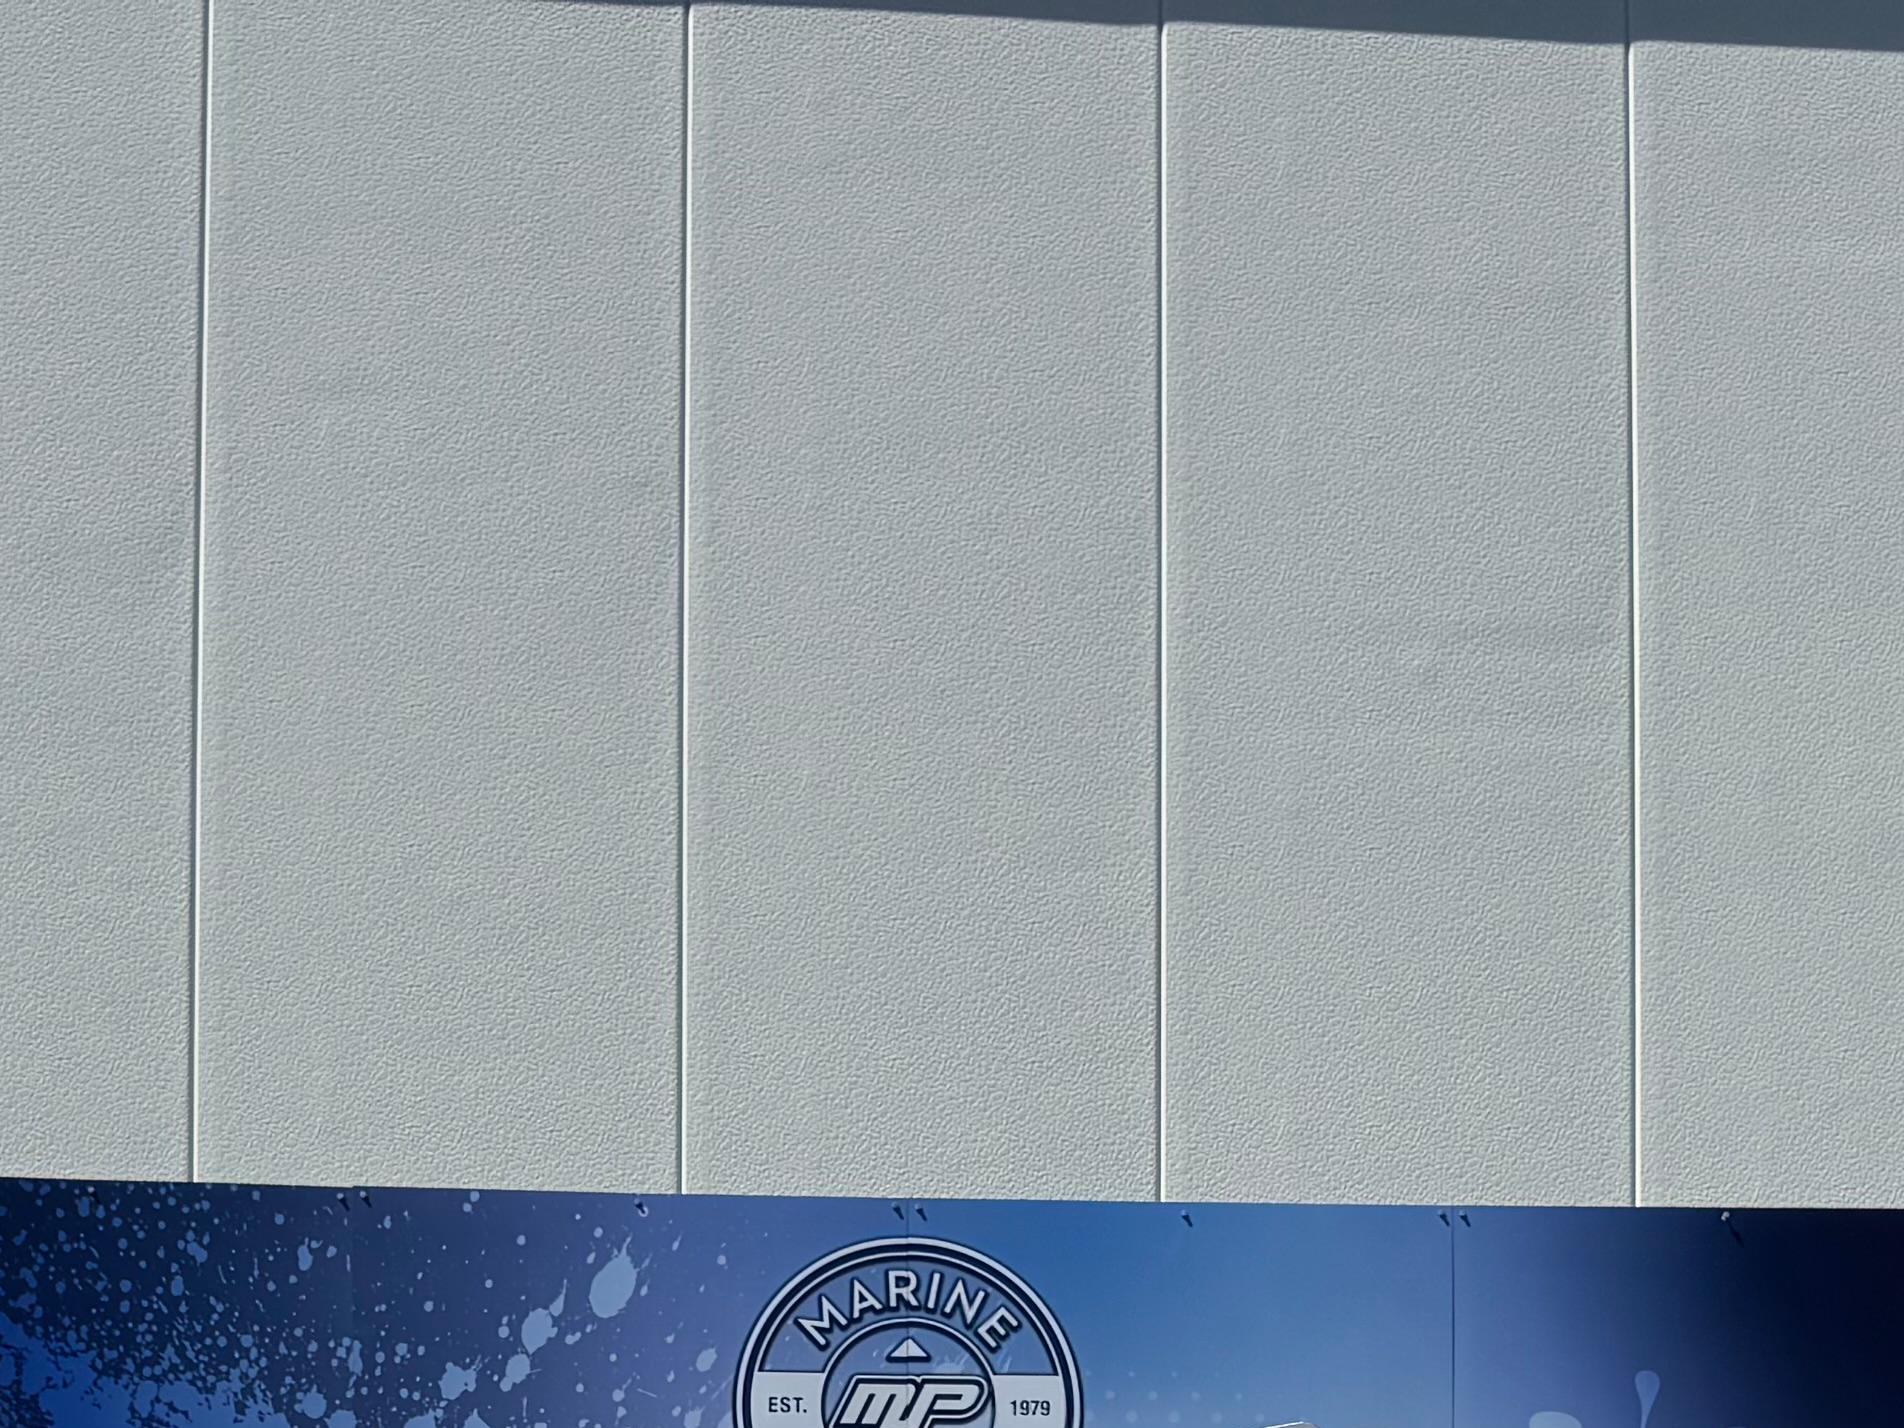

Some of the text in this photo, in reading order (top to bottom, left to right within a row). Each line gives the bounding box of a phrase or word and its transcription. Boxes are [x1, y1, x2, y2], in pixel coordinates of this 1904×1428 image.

[797, 1269, 1020, 1352] MARINE
[767, 1396, 808, 1415] EST.
[1009, 1399, 1052, 1418] 1979
